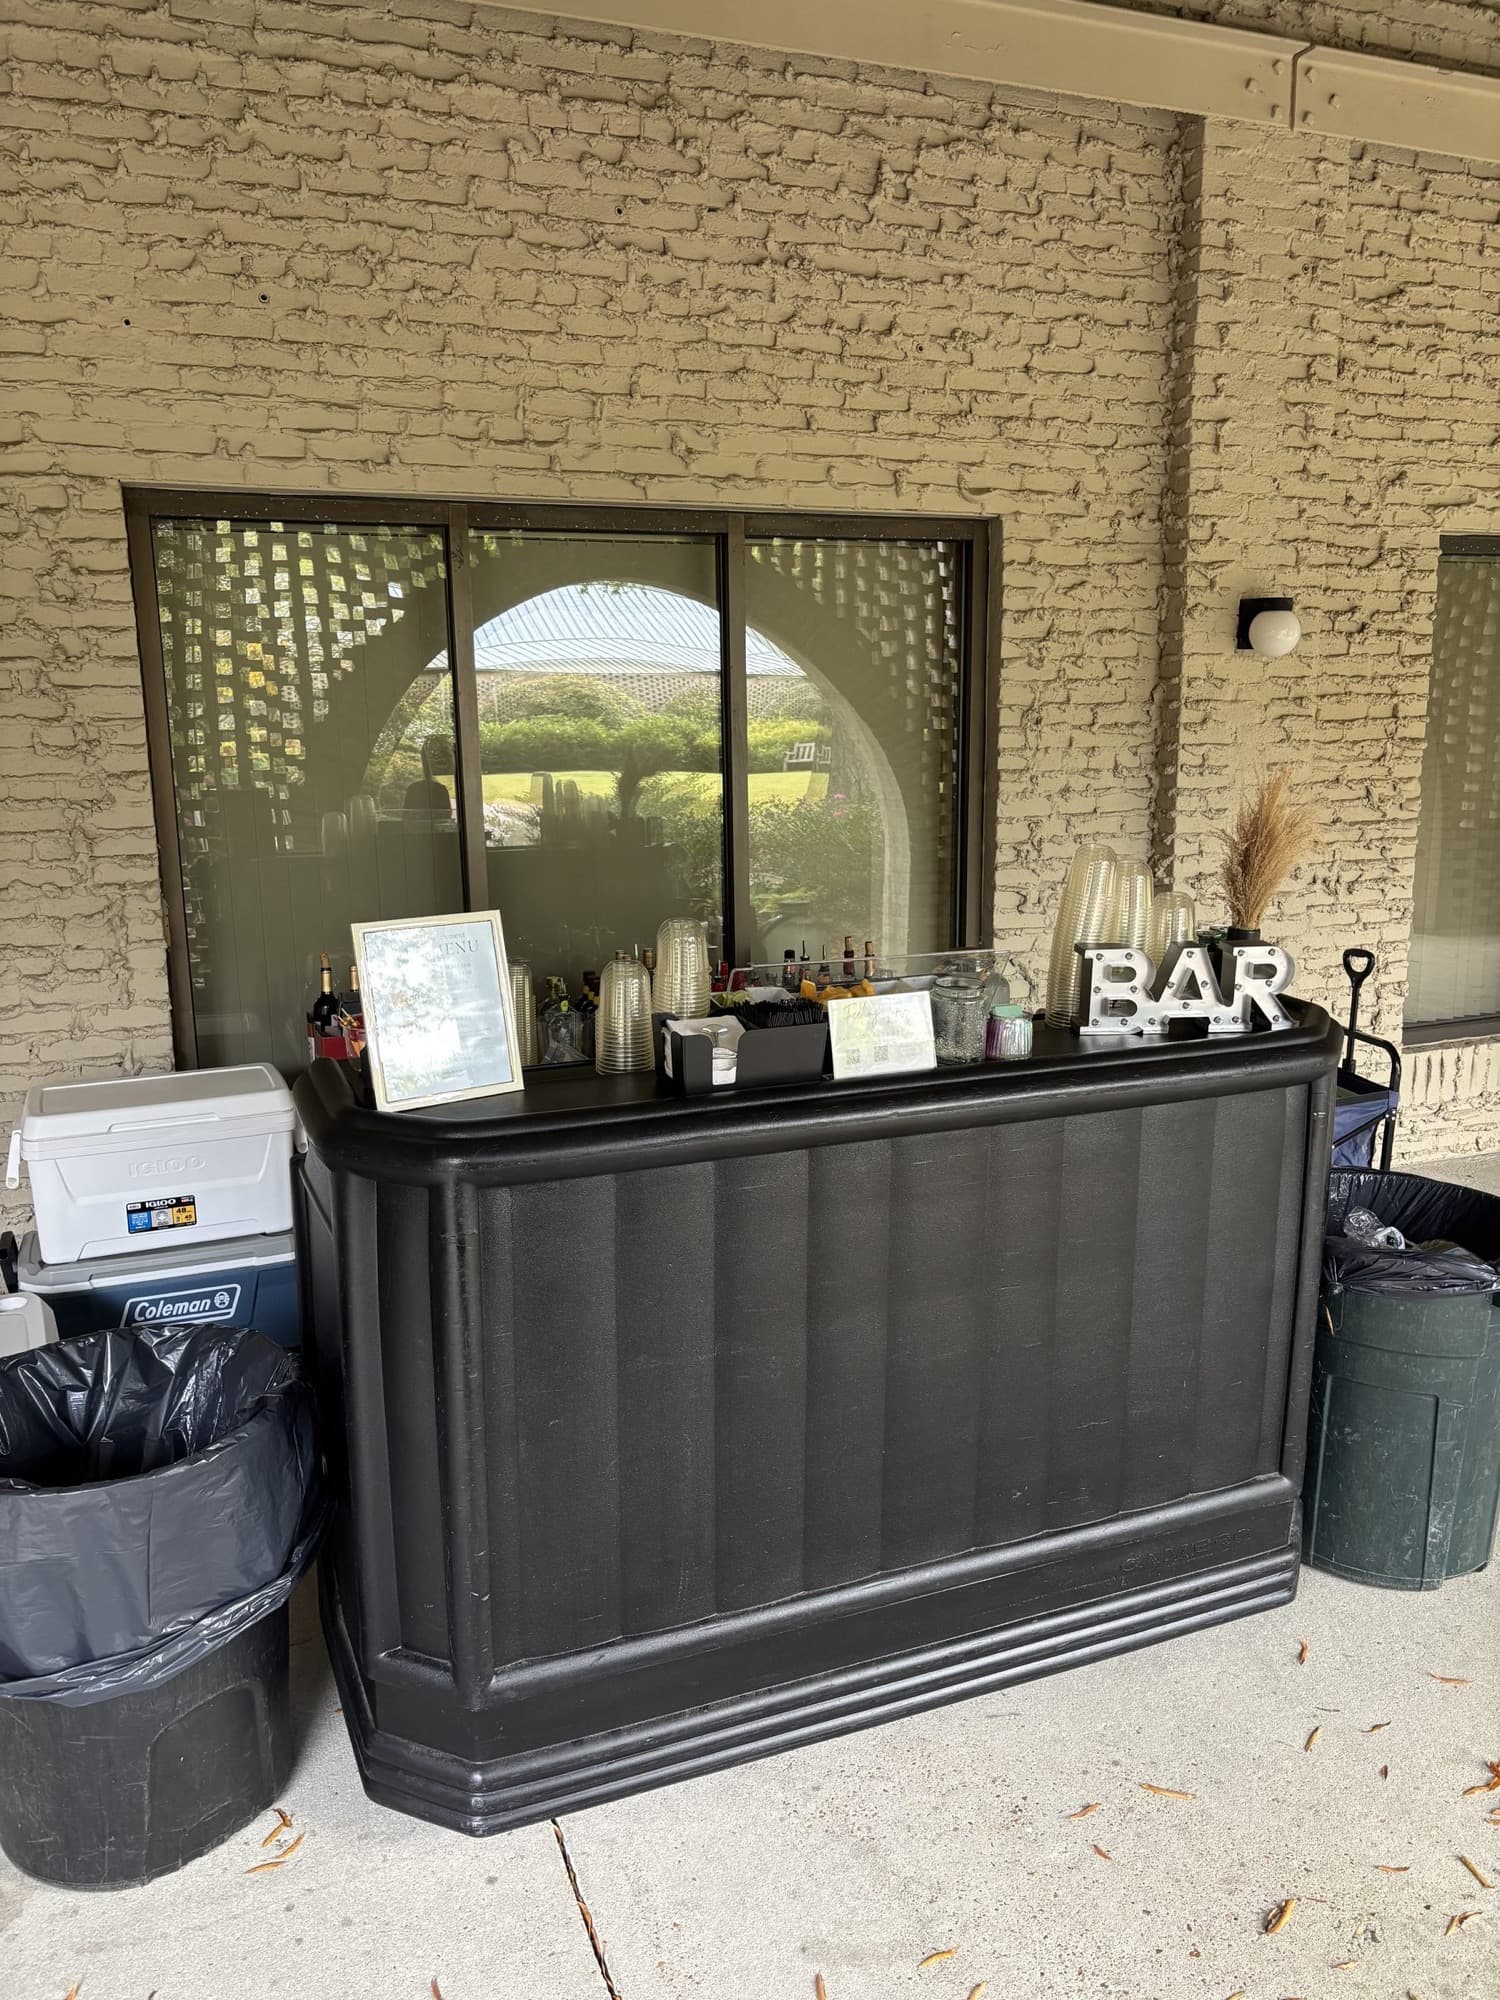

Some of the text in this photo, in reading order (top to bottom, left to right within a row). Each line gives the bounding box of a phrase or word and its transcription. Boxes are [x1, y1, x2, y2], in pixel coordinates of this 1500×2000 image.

[1075, 942, 1300, 1036] BAR
[127, 1153, 208, 1178] IGLOO
[145, 1199, 176, 1208] IGLOO
[134, 1298, 211, 1322] Coleman
